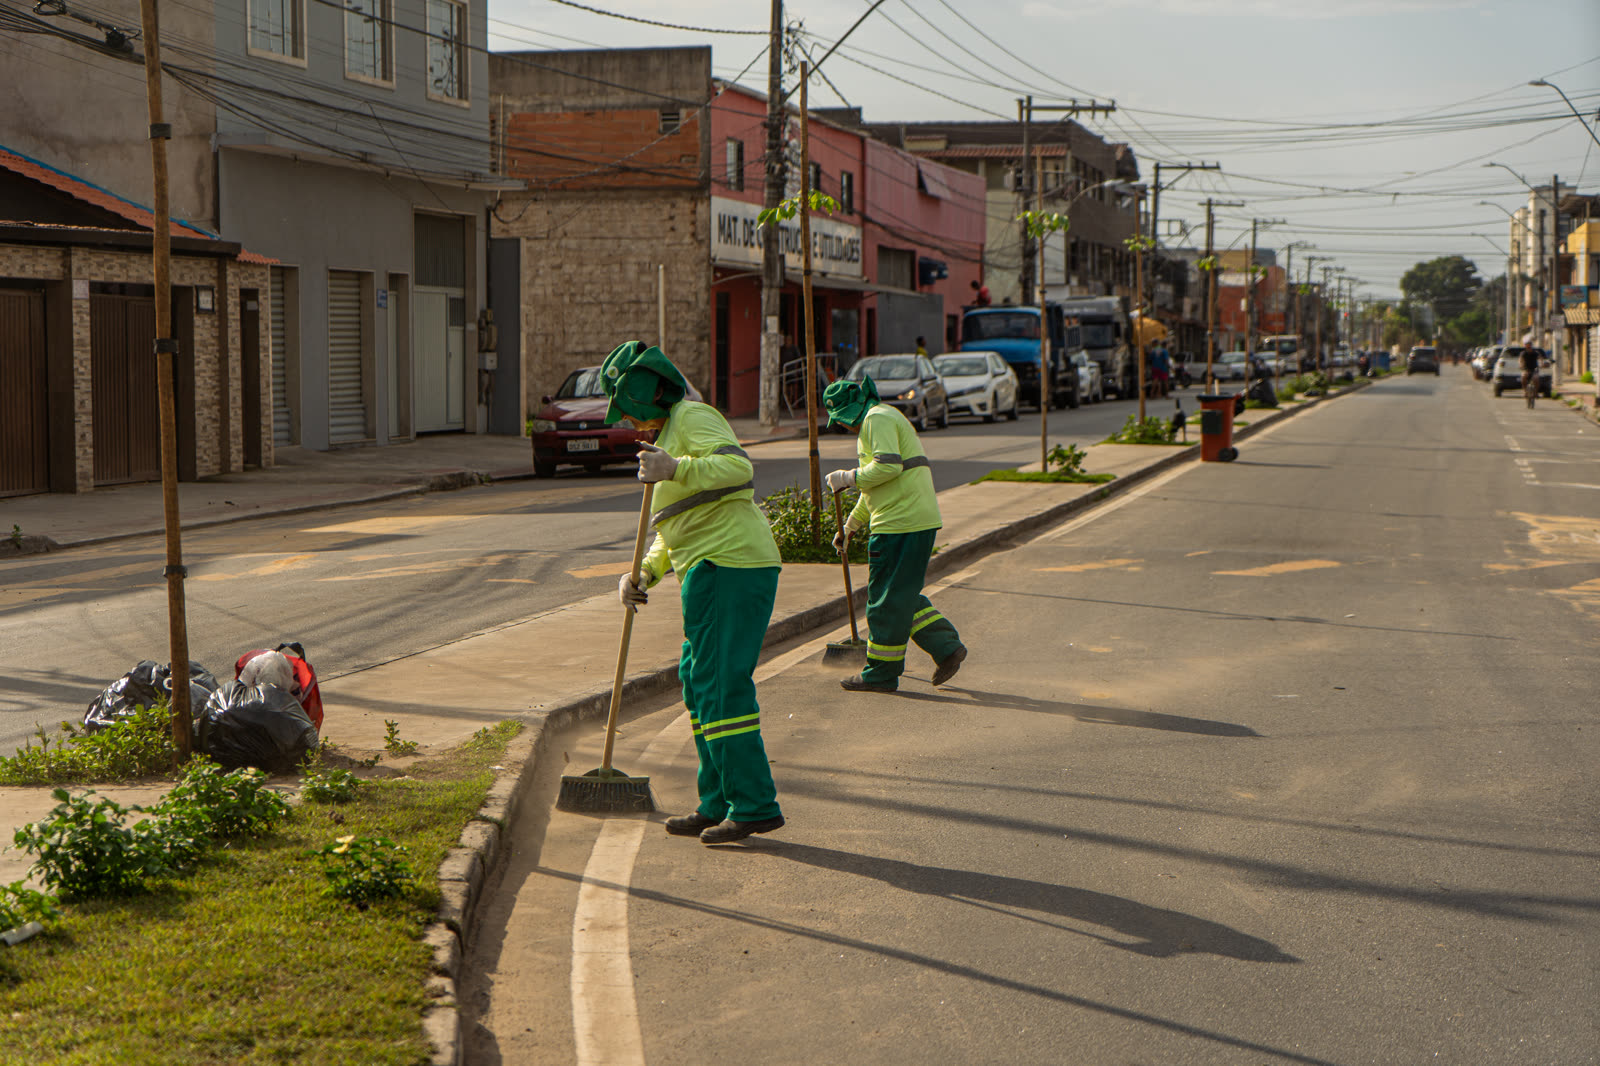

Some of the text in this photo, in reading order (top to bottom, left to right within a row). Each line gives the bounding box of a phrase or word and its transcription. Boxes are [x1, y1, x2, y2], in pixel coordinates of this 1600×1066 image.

[718, 212, 860, 264] MAT. DE CTRUÇ E UTILIDADES
